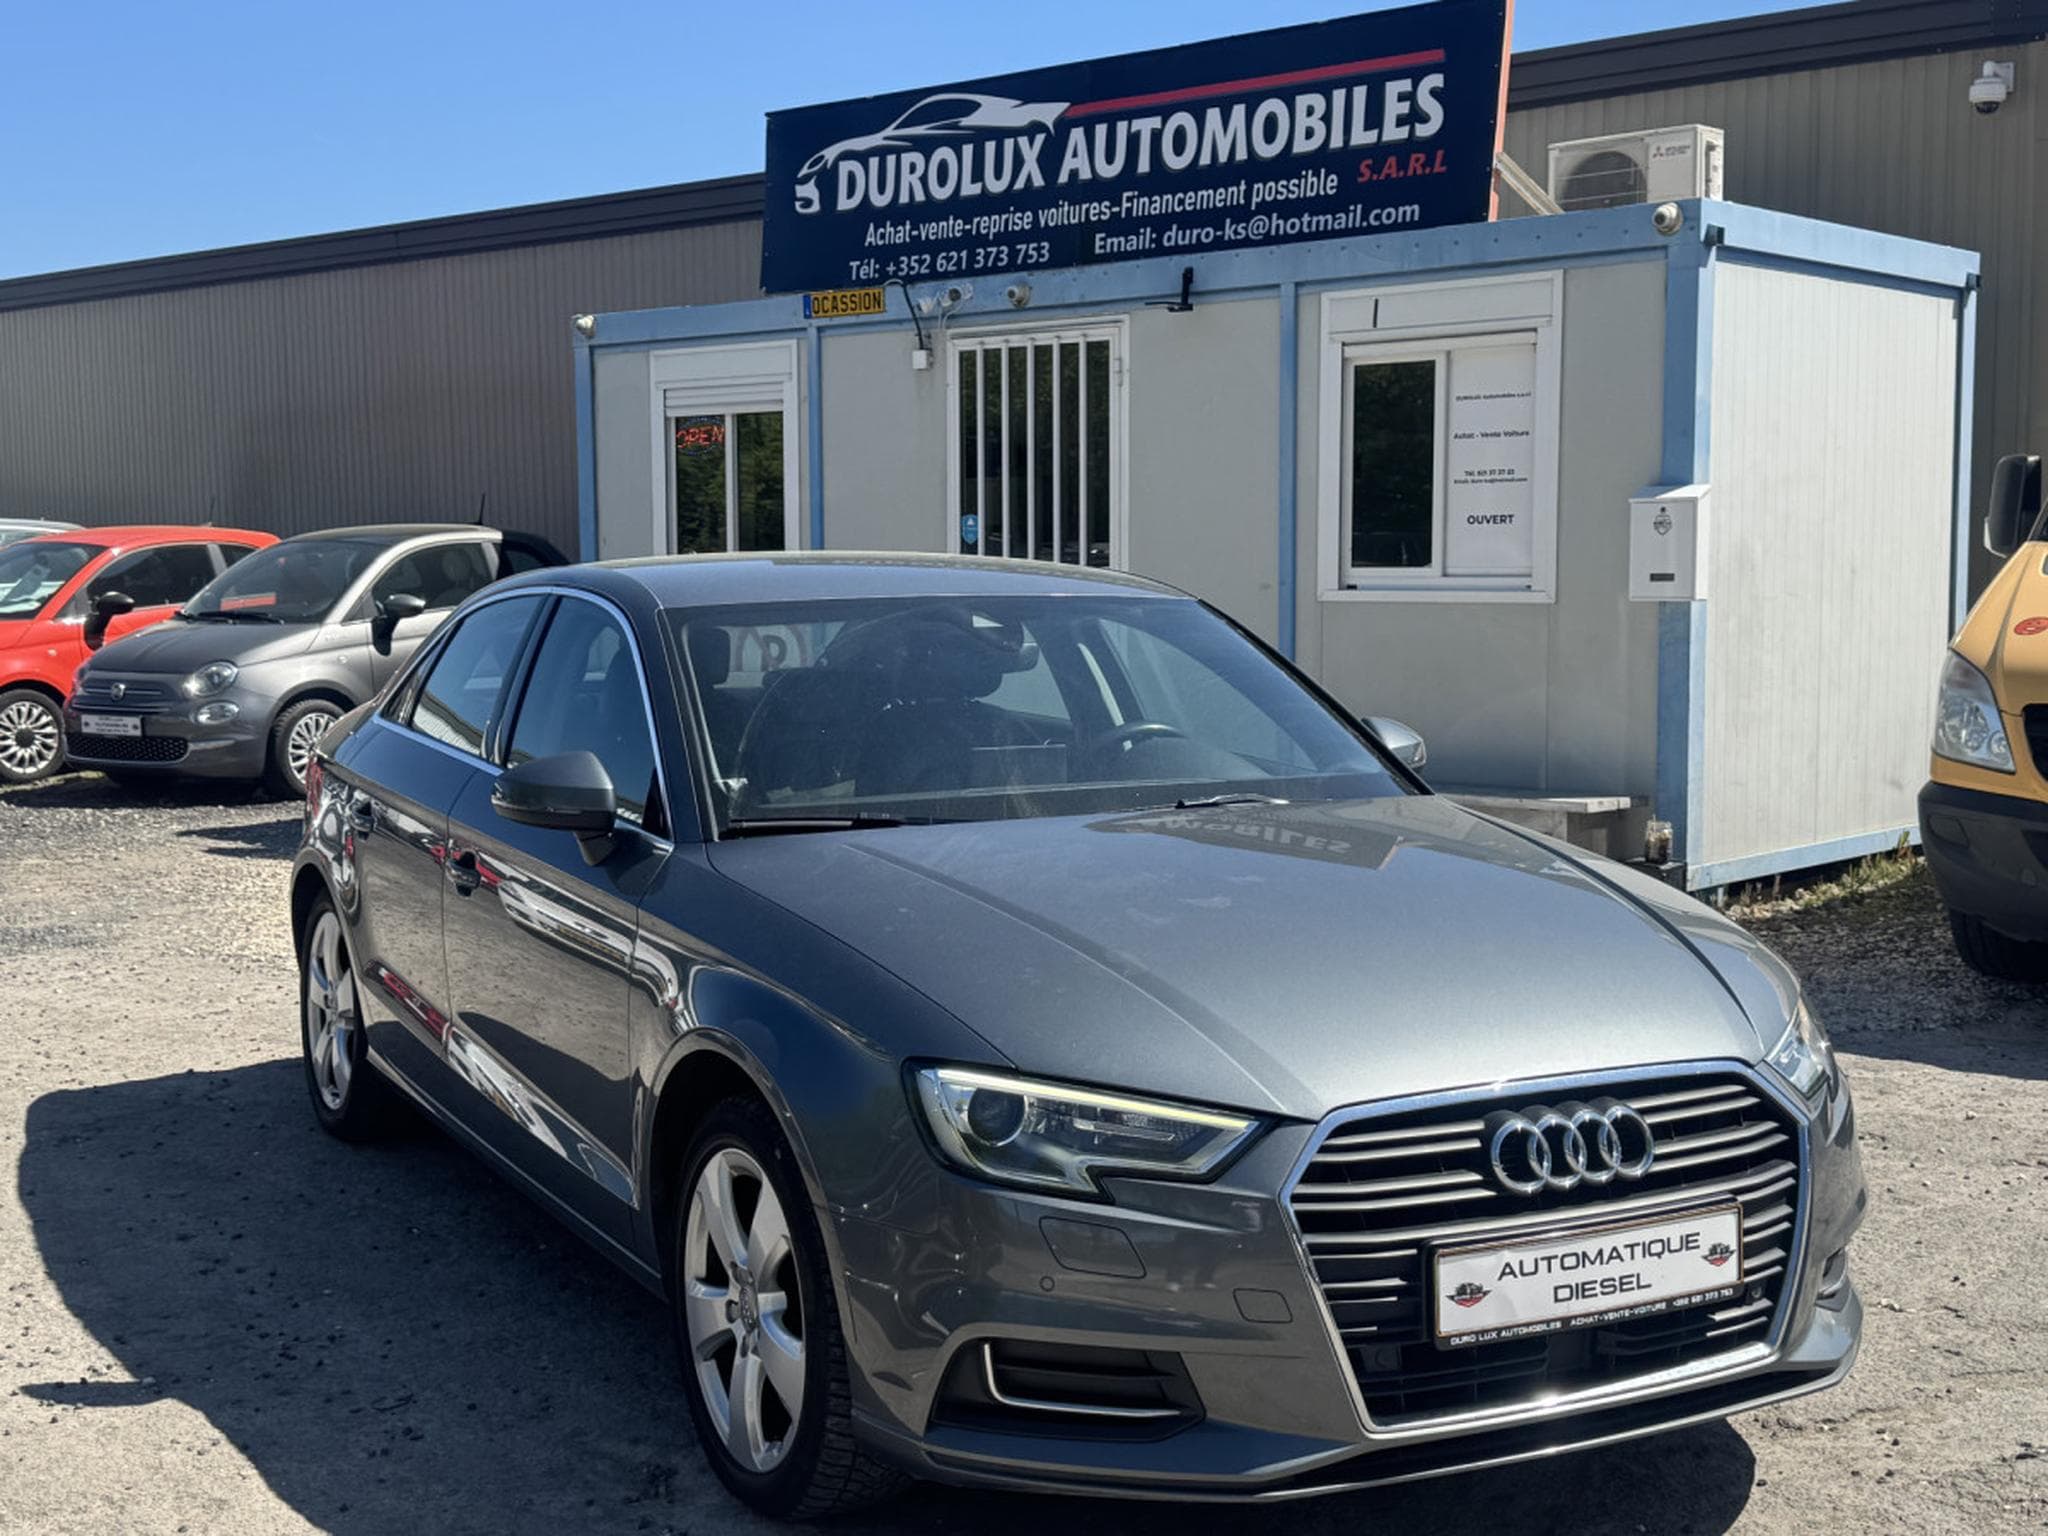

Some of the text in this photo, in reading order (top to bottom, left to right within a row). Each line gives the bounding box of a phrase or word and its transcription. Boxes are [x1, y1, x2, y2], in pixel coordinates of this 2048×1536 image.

[837, 73, 1446, 211] DUROLUX AUTOMOBILES
[1357, 149, 1448, 184] S.A.R.L
[864, 168, 1339, 247] Achat-vente-reprise voitures-Financement possible
[1095, 200, 1421, 255] Email: duro-ks@hotmail.com
[850, 242, 1051, 281] Tél: +352 621 373 753
[812, 291, 882, 314] OCASSION
[676, 425, 725, 448] OPEN
[1467, 514, 1514, 525] OUVERT
[1497, 1232, 1701, 1281] AUTOMATIQUE
[1553, 1273, 1652, 1303] DIESEL
[1479, 1331, 1498, 1341] LUX
